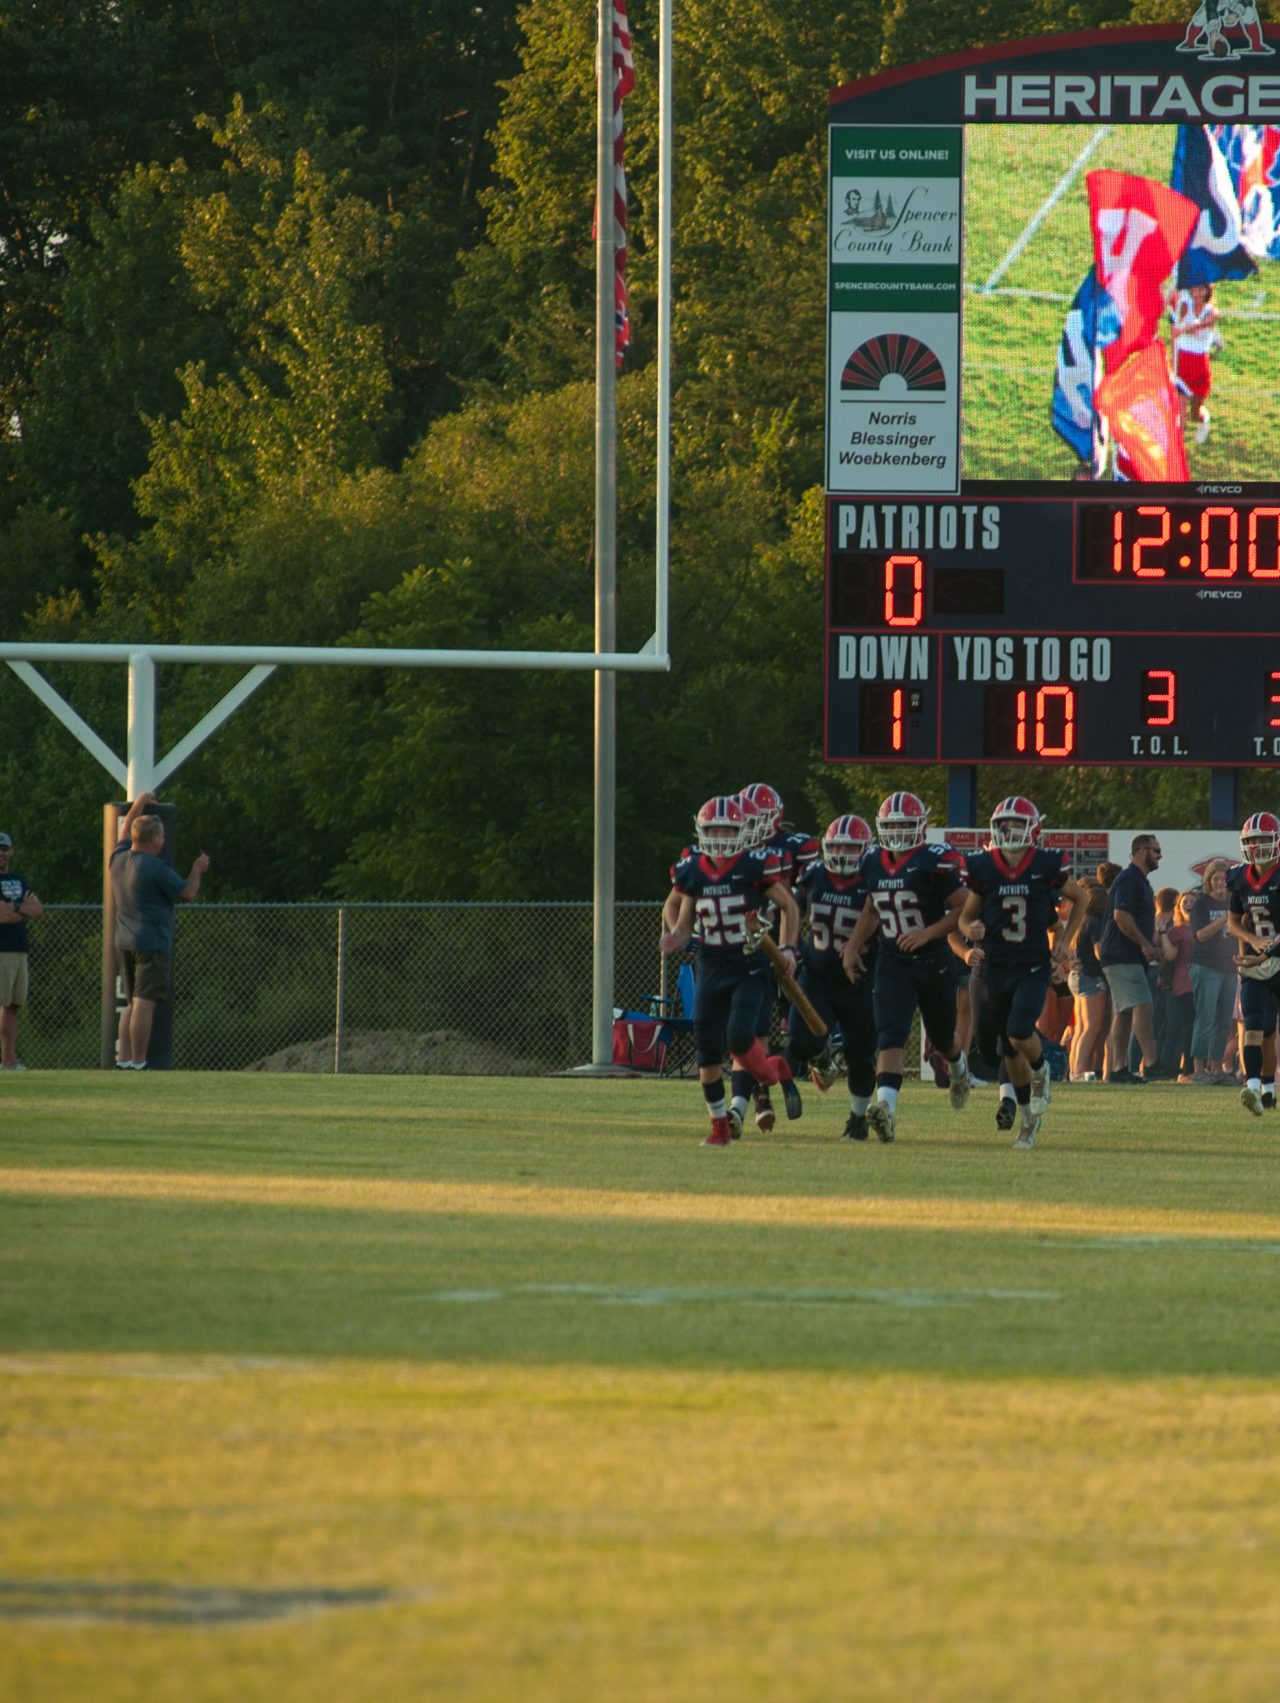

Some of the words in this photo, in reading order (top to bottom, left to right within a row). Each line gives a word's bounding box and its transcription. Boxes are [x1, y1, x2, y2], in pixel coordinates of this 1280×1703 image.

[845, 149, 877, 160] VISIT
[879, 149, 896, 160] US
[898, 149, 949, 160] ONLINE!
[888, 186, 958, 237] Spencer
[833, 228, 894, 256] County
[901, 229, 953, 253] Bank
[834, 281, 957, 291] SPENCERCOUNTYBANK.COM
[850, 432, 936, 448] Blessinger
[868, 411, 917, 426] Norris
[839, 451, 947, 470] Woebkenberg
[838, 504, 1000, 550] PATRIOTS
[884, 555, 923, 627] 0
[838, 635, 929, 680] DOWN
[953, 636, 1015, 682] YDS
[1023, 637, 1061, 682] TO
[1069, 637, 1112, 682] GO
[892, 689, 902, 751] 1
[1147, 670, 1176, 726] 3
[1016, 685, 1074, 757] 10
[702, 884, 731, 896] PATRIOTS
[821, 892, 851, 906] PATRIOTS
[878, 878, 904, 889] PATRIOTS
[999, 884, 1030, 896] PATRIOTS
[695, 895, 746, 946] 25
[810, 902, 860, 951] 55
[870, 890, 925, 939] 56
[1002, 896, 1027, 943] 3
[1250, 905, 1276, 942] 6
